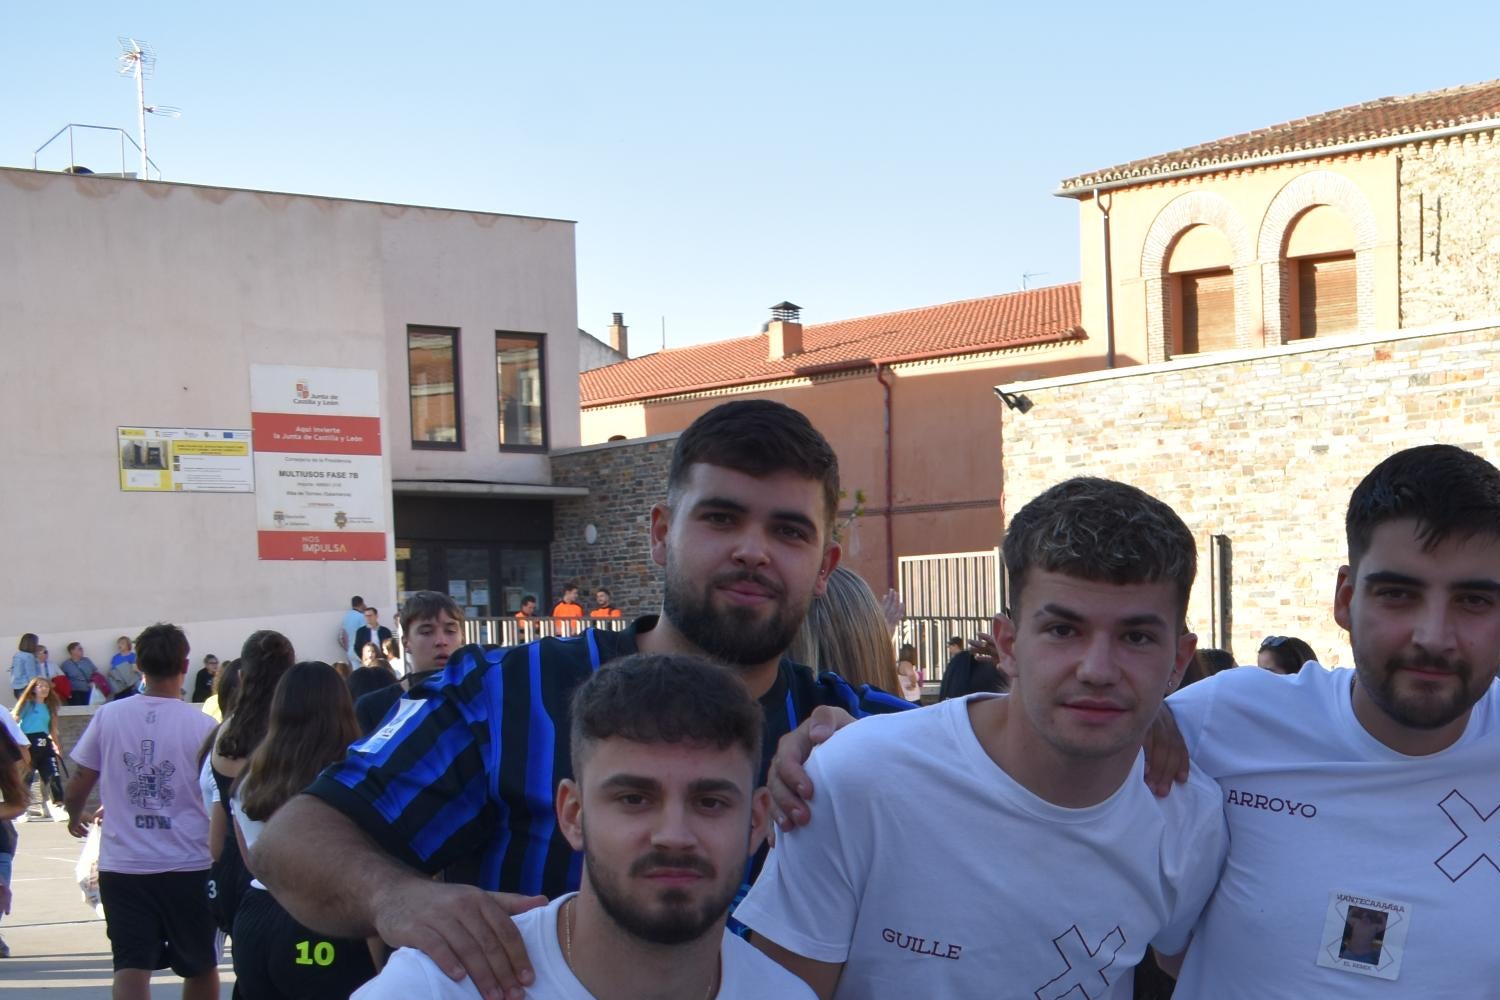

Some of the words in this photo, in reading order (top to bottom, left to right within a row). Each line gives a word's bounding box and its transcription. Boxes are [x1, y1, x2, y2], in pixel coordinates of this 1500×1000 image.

[279, 470, 324, 478] MULTIUSOS
[1227, 789, 1317, 818] ARROYO
[208, 879, 217, 899] 3
[295, 940, 335, 966] 10
[882, 928, 962, 960] GUILLE
